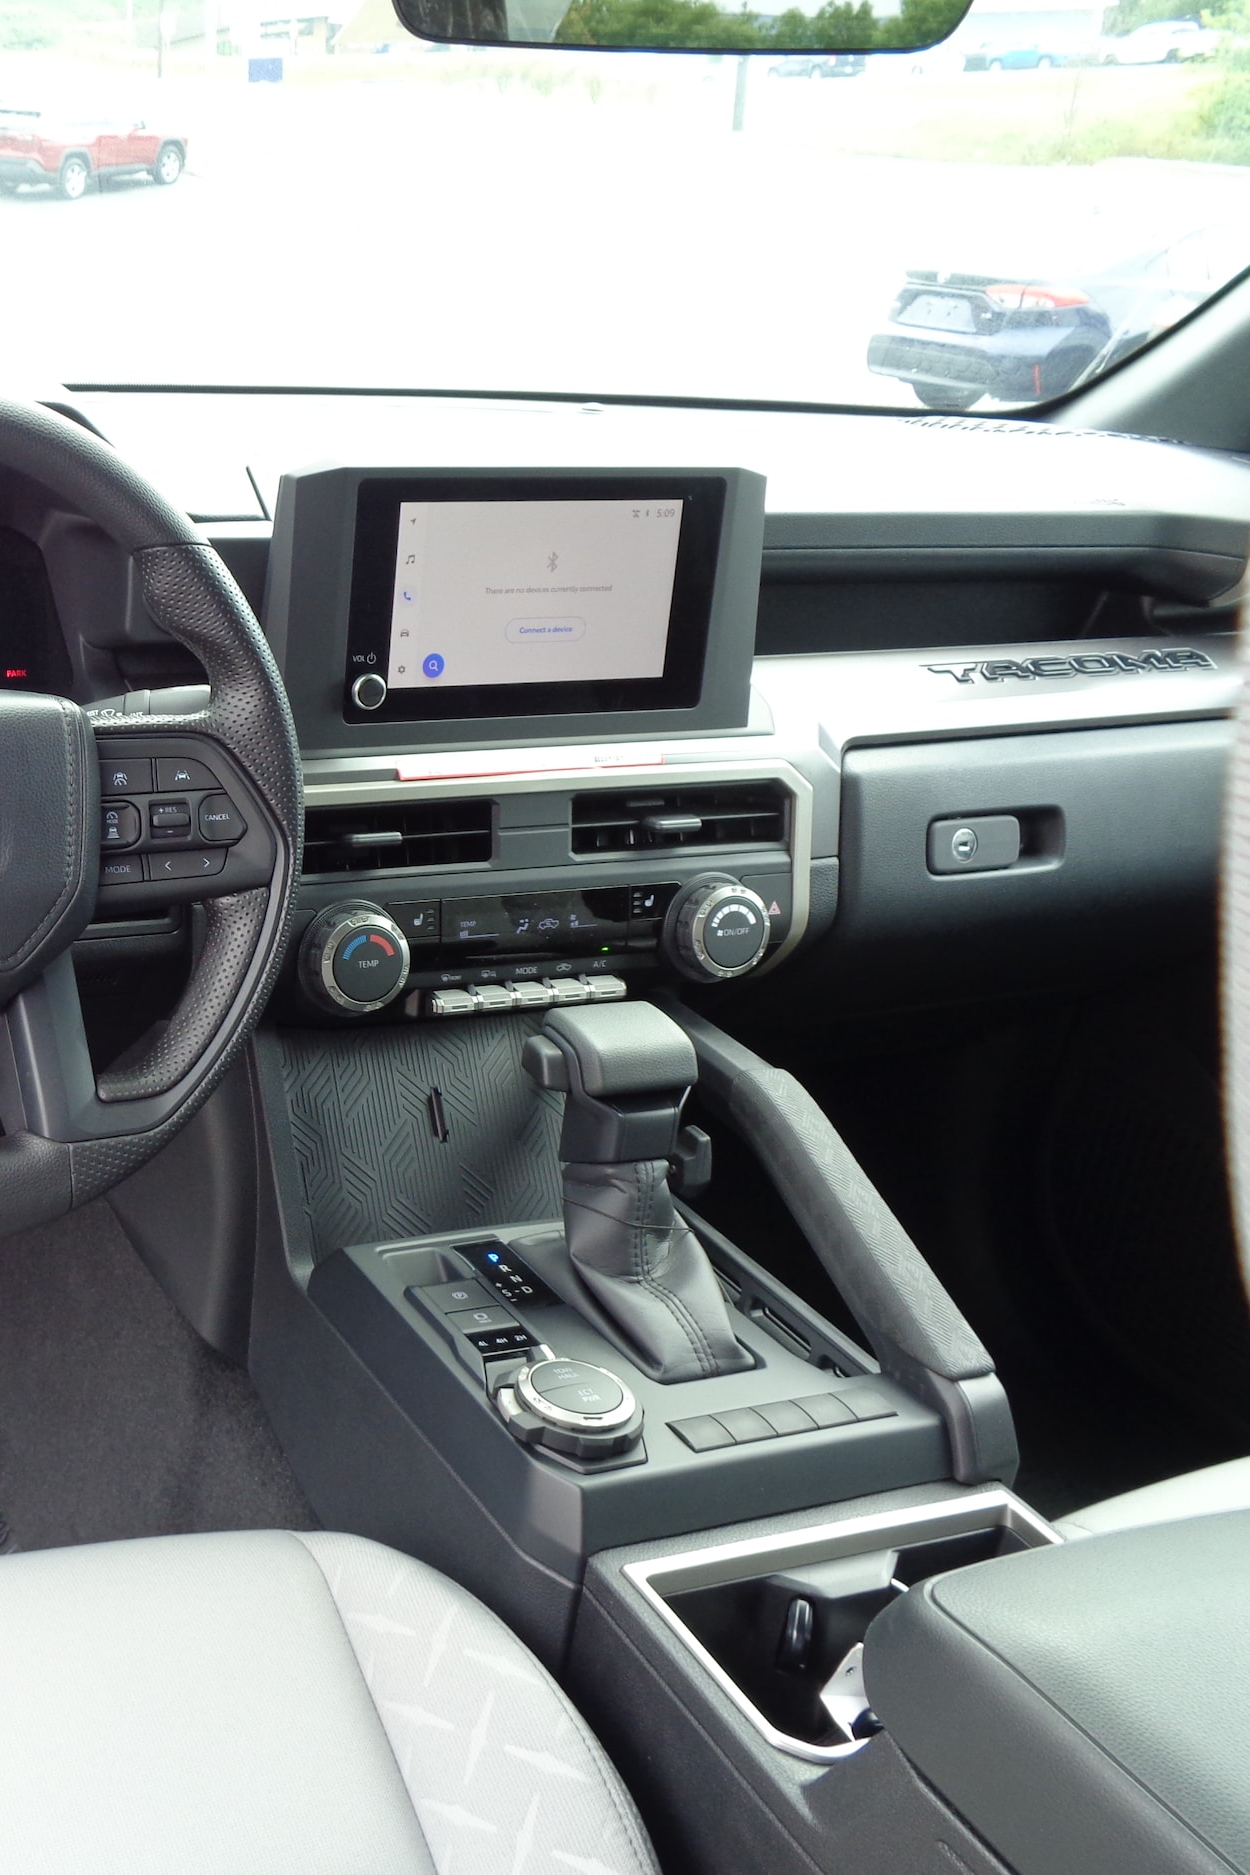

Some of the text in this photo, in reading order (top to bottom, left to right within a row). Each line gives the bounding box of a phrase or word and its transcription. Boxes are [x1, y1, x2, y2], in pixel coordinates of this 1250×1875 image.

[656, 508, 676, 518] 5:09
[485, 587, 504, 595] There
[526, 586, 550, 594] devices
[550, 585, 579, 594] currently
[579, 584, 613, 592] connected
[519, 626, 547, 634] Connect
[919, 647, 1218, 684] TACOMA
[6, 669, 27, 678] PARK
[204, 812, 231, 821] CANCEL
[105, 864, 132, 874] MODE
[460, 920, 477, 928] TEMP
[723, 927, 751, 937] ON/OFF
[358, 959, 379, 969] TEMP
[593, 960, 607, 968] A/C
[516, 966, 539, 975] MODE
[488, 1253, 499, 1263] P
[498, 1264, 512, 1273] R
[510, 1274, 523, 1283] N
[501, 1289, 512, 1297] S
[521, 1285, 534, 1294] D
